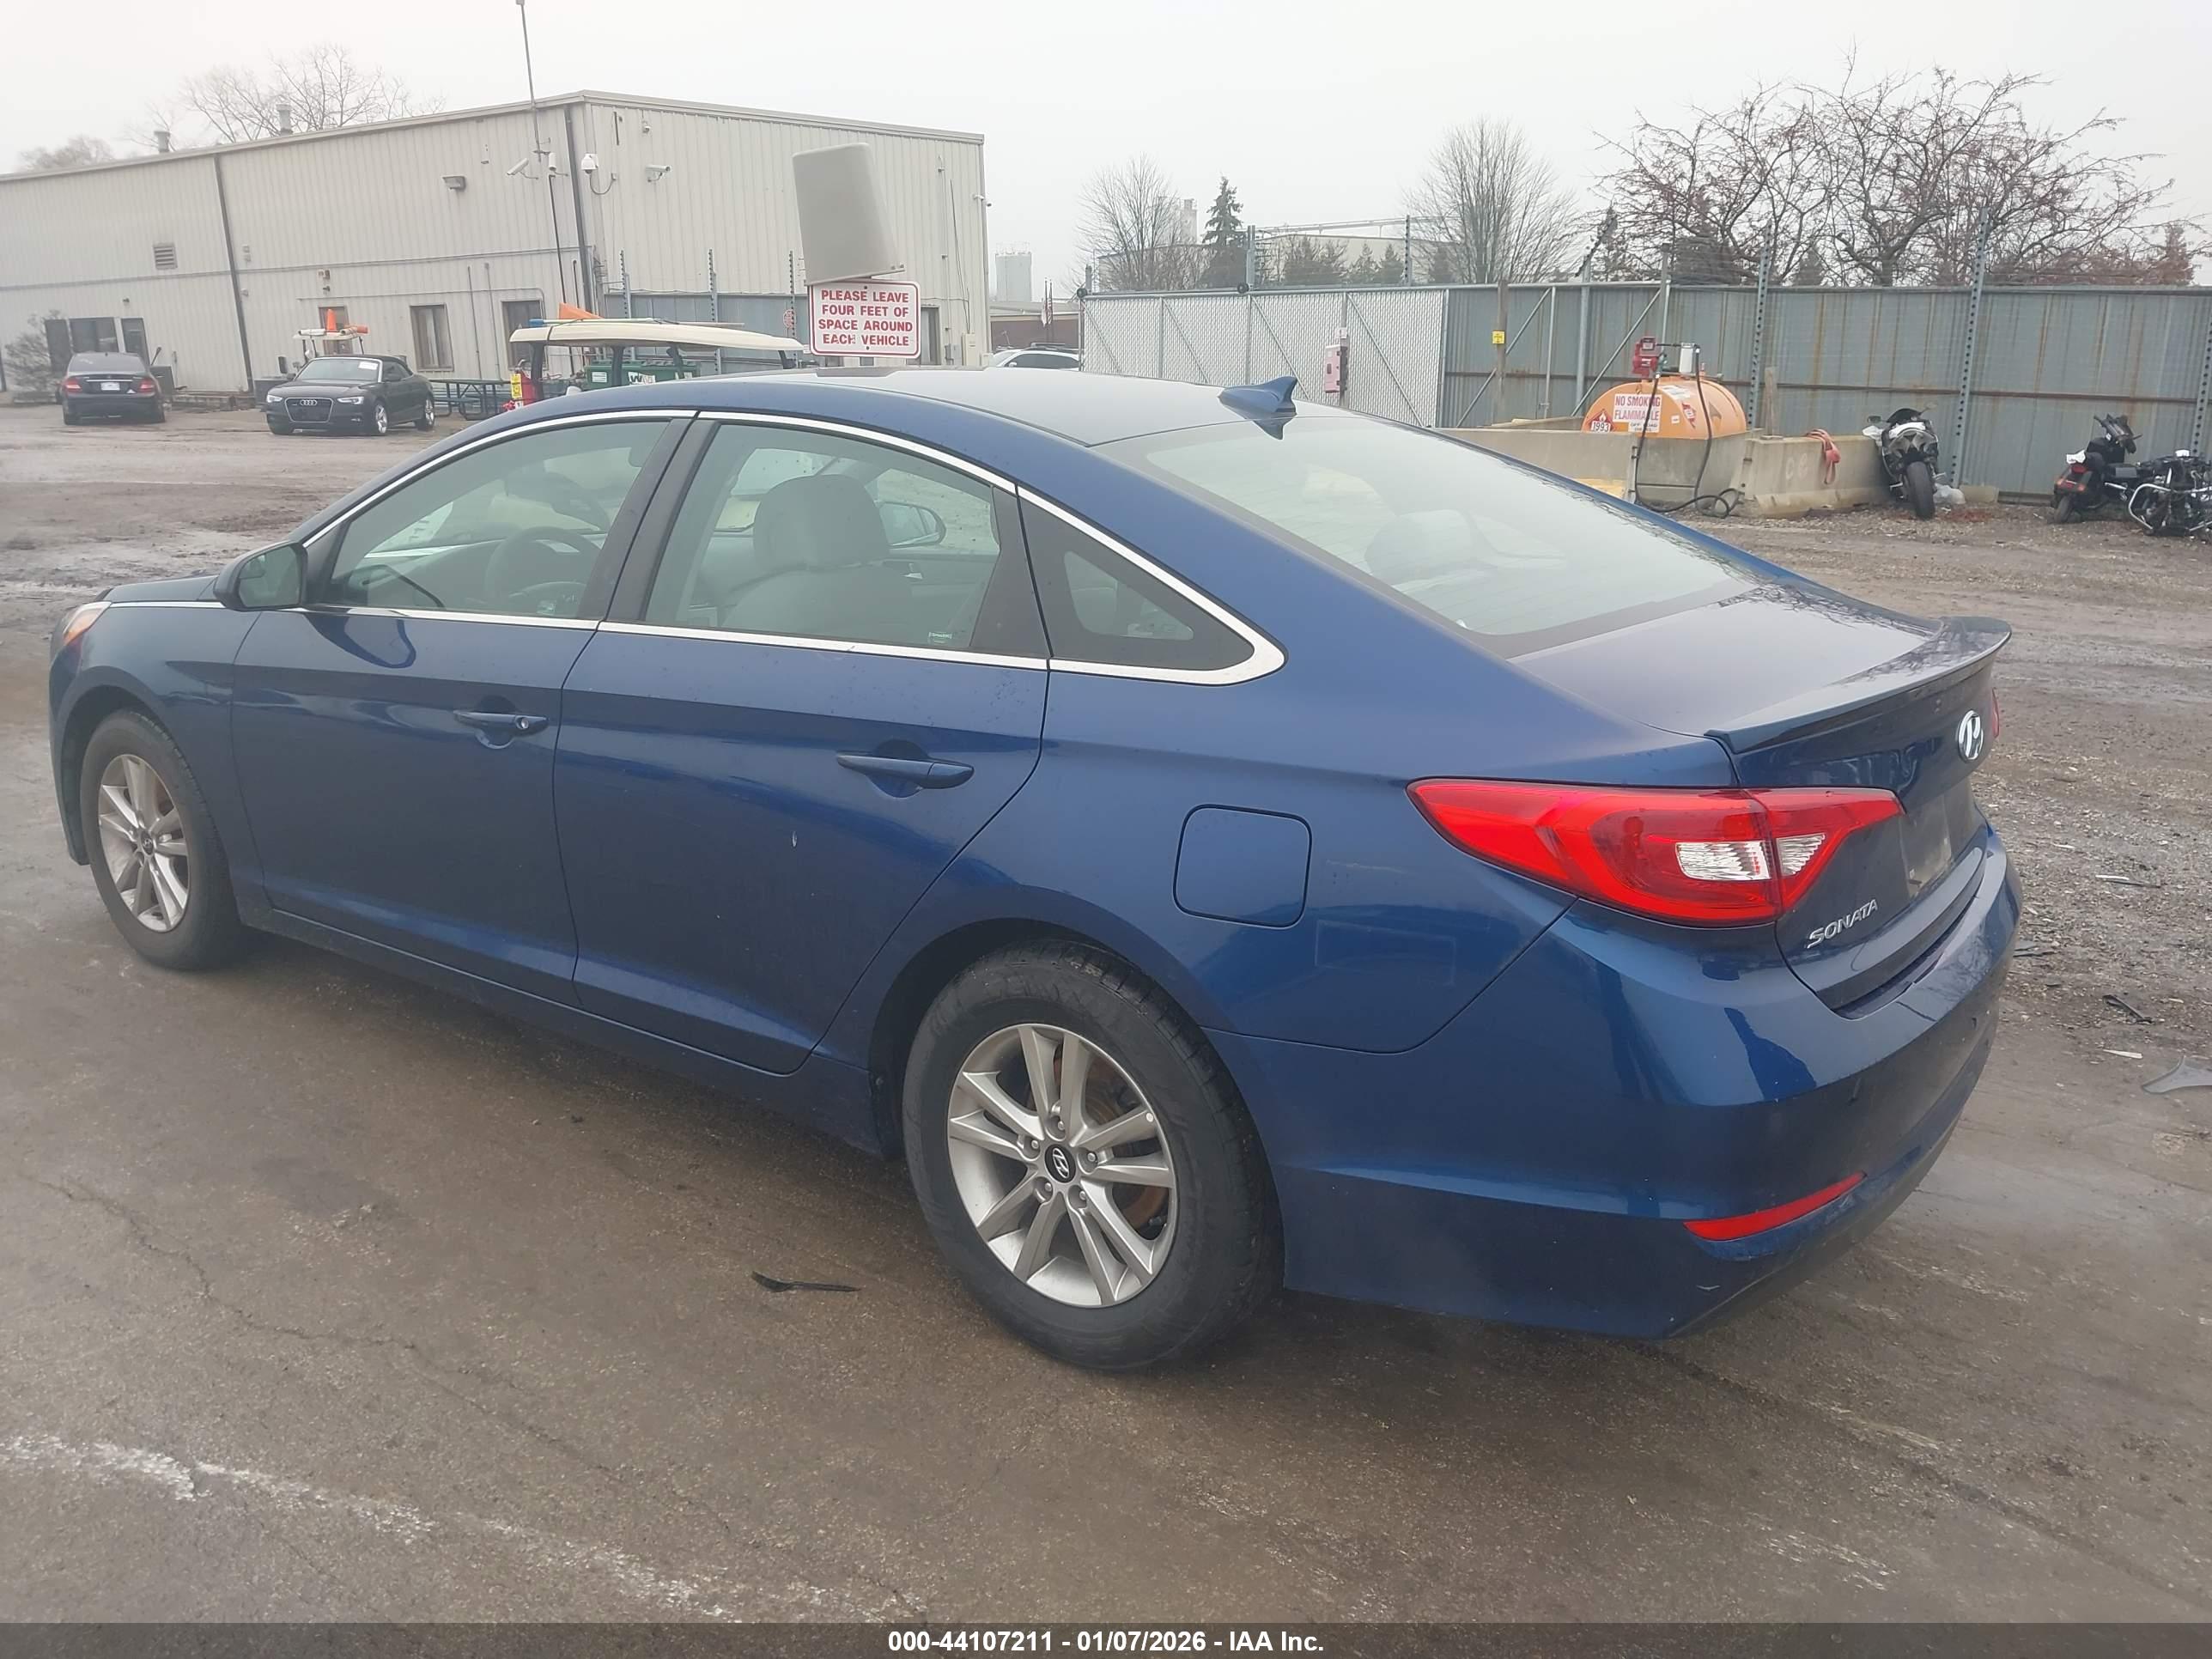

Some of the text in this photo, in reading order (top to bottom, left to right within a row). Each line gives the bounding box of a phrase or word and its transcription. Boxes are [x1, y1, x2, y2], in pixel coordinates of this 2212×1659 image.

[821, 289, 908, 303] PLEASE LEAVE
[822, 304, 908, 318] FOUR FEET OF
[818, 319, 913, 332] SPACE AROUND
[823, 333, 909, 346] EACH VEHICLE
[1615, 395, 1626, 406] NO
[1614, 410, 1660, 421] FLAMMALE
[1593, 422, 1609, 432] 1993
[1807, 899, 1879, 949] SONATA
